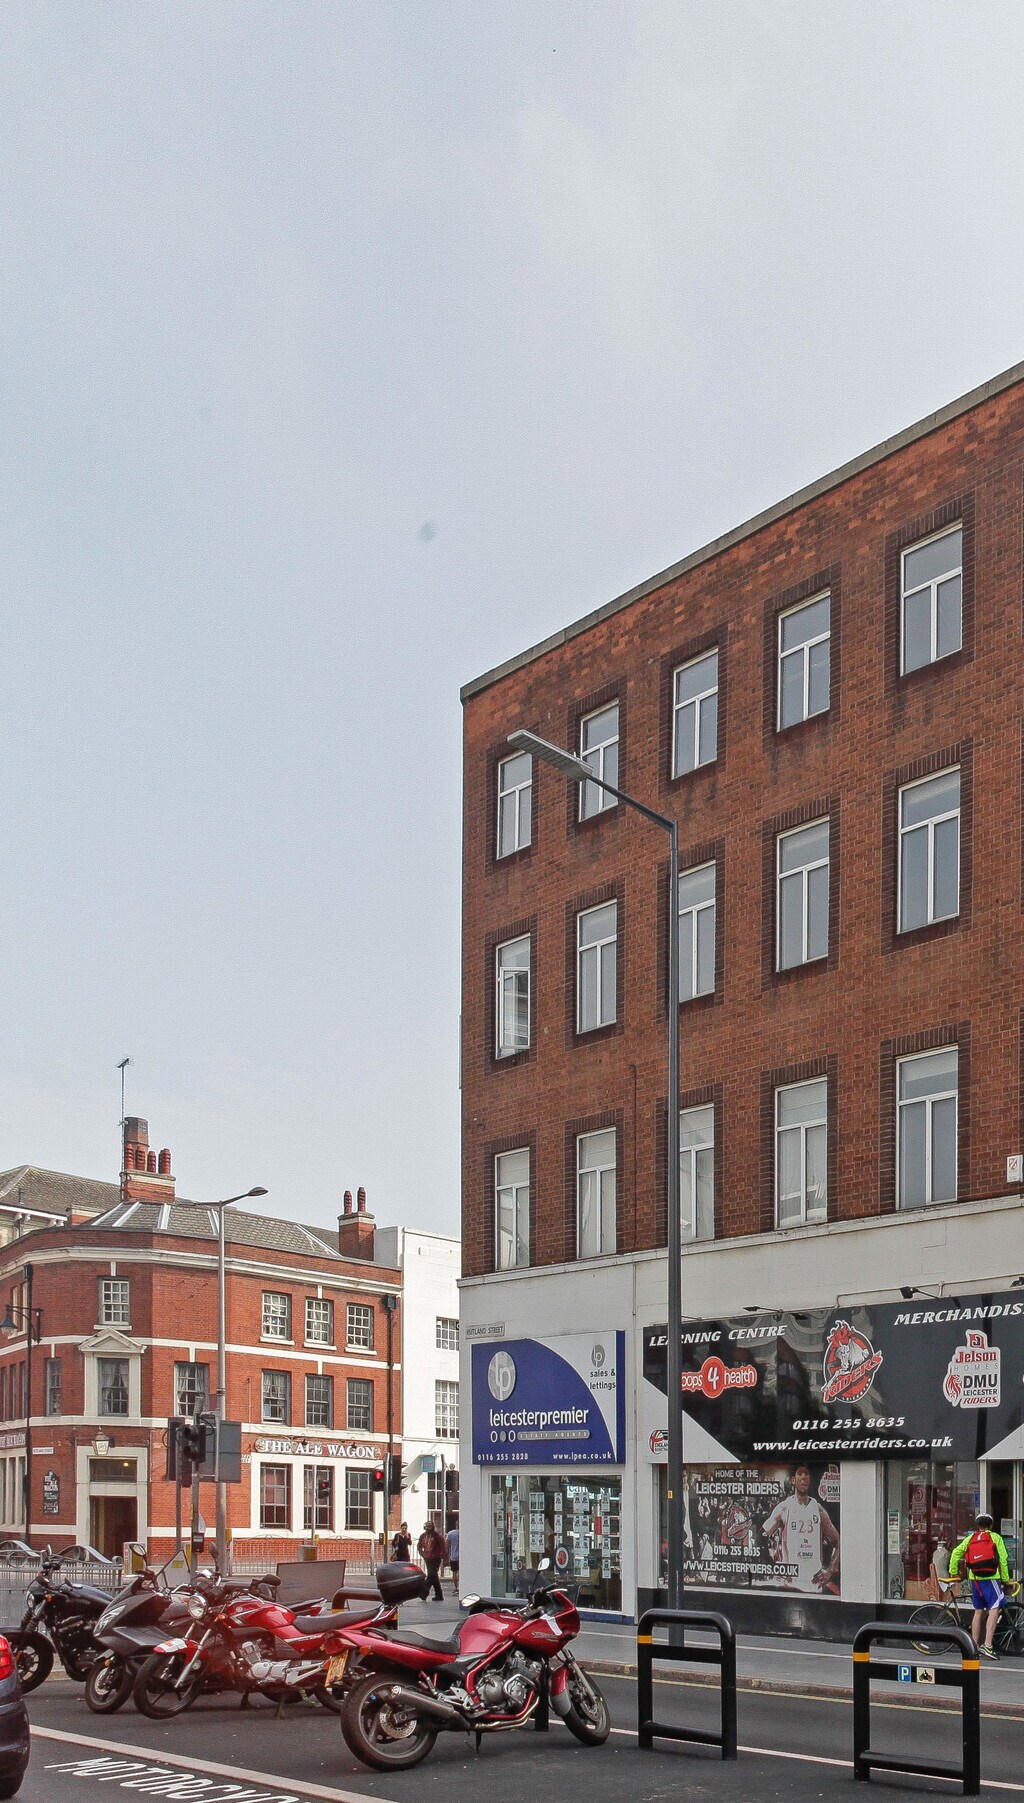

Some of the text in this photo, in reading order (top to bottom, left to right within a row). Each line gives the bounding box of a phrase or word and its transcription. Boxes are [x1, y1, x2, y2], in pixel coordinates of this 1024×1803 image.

[466, 1325, 504, 1336] RUTLAND STREET
[649, 1324, 788, 1347] LENING CENTRE
[955, 1350, 997, 1364] Jelson
[589, 1368, 616, 1378] sales &
[954, 1362, 999, 1372] HOMES
[681, 1366, 755, 1390] oops 4 health
[963, 1374, 998, 1389] DMU
[589, 1381, 617, 1391] lettings
[963, 1388, 998, 1397] LEICESTER
[963, 1396, 998, 1405] RIDERS
[489, 1406, 589, 1430] leicesterpremier
[792, 1416, 906, 1431] 0116 255 8635
[263, 1440, 375, 1458] THE ALE WAGON
[753, 1436, 954, 1451] www.leicesterriders.co.uk
[477, 1453, 494, 1461] 0116
[511, 1452, 529, 1460] 2828
[552, 1451, 612, 1461] www.lpea.co.uk
[715, 1469, 759, 1478] HOME OF THE
[696, 1482, 780, 1495] LEICESTER RIDERS
[798, 1519, 814, 1534] 23
[714, 1544, 729, 1555] 0116
[730, 1545, 742, 1556] 255
[901, 1666, 909, 1681] P
